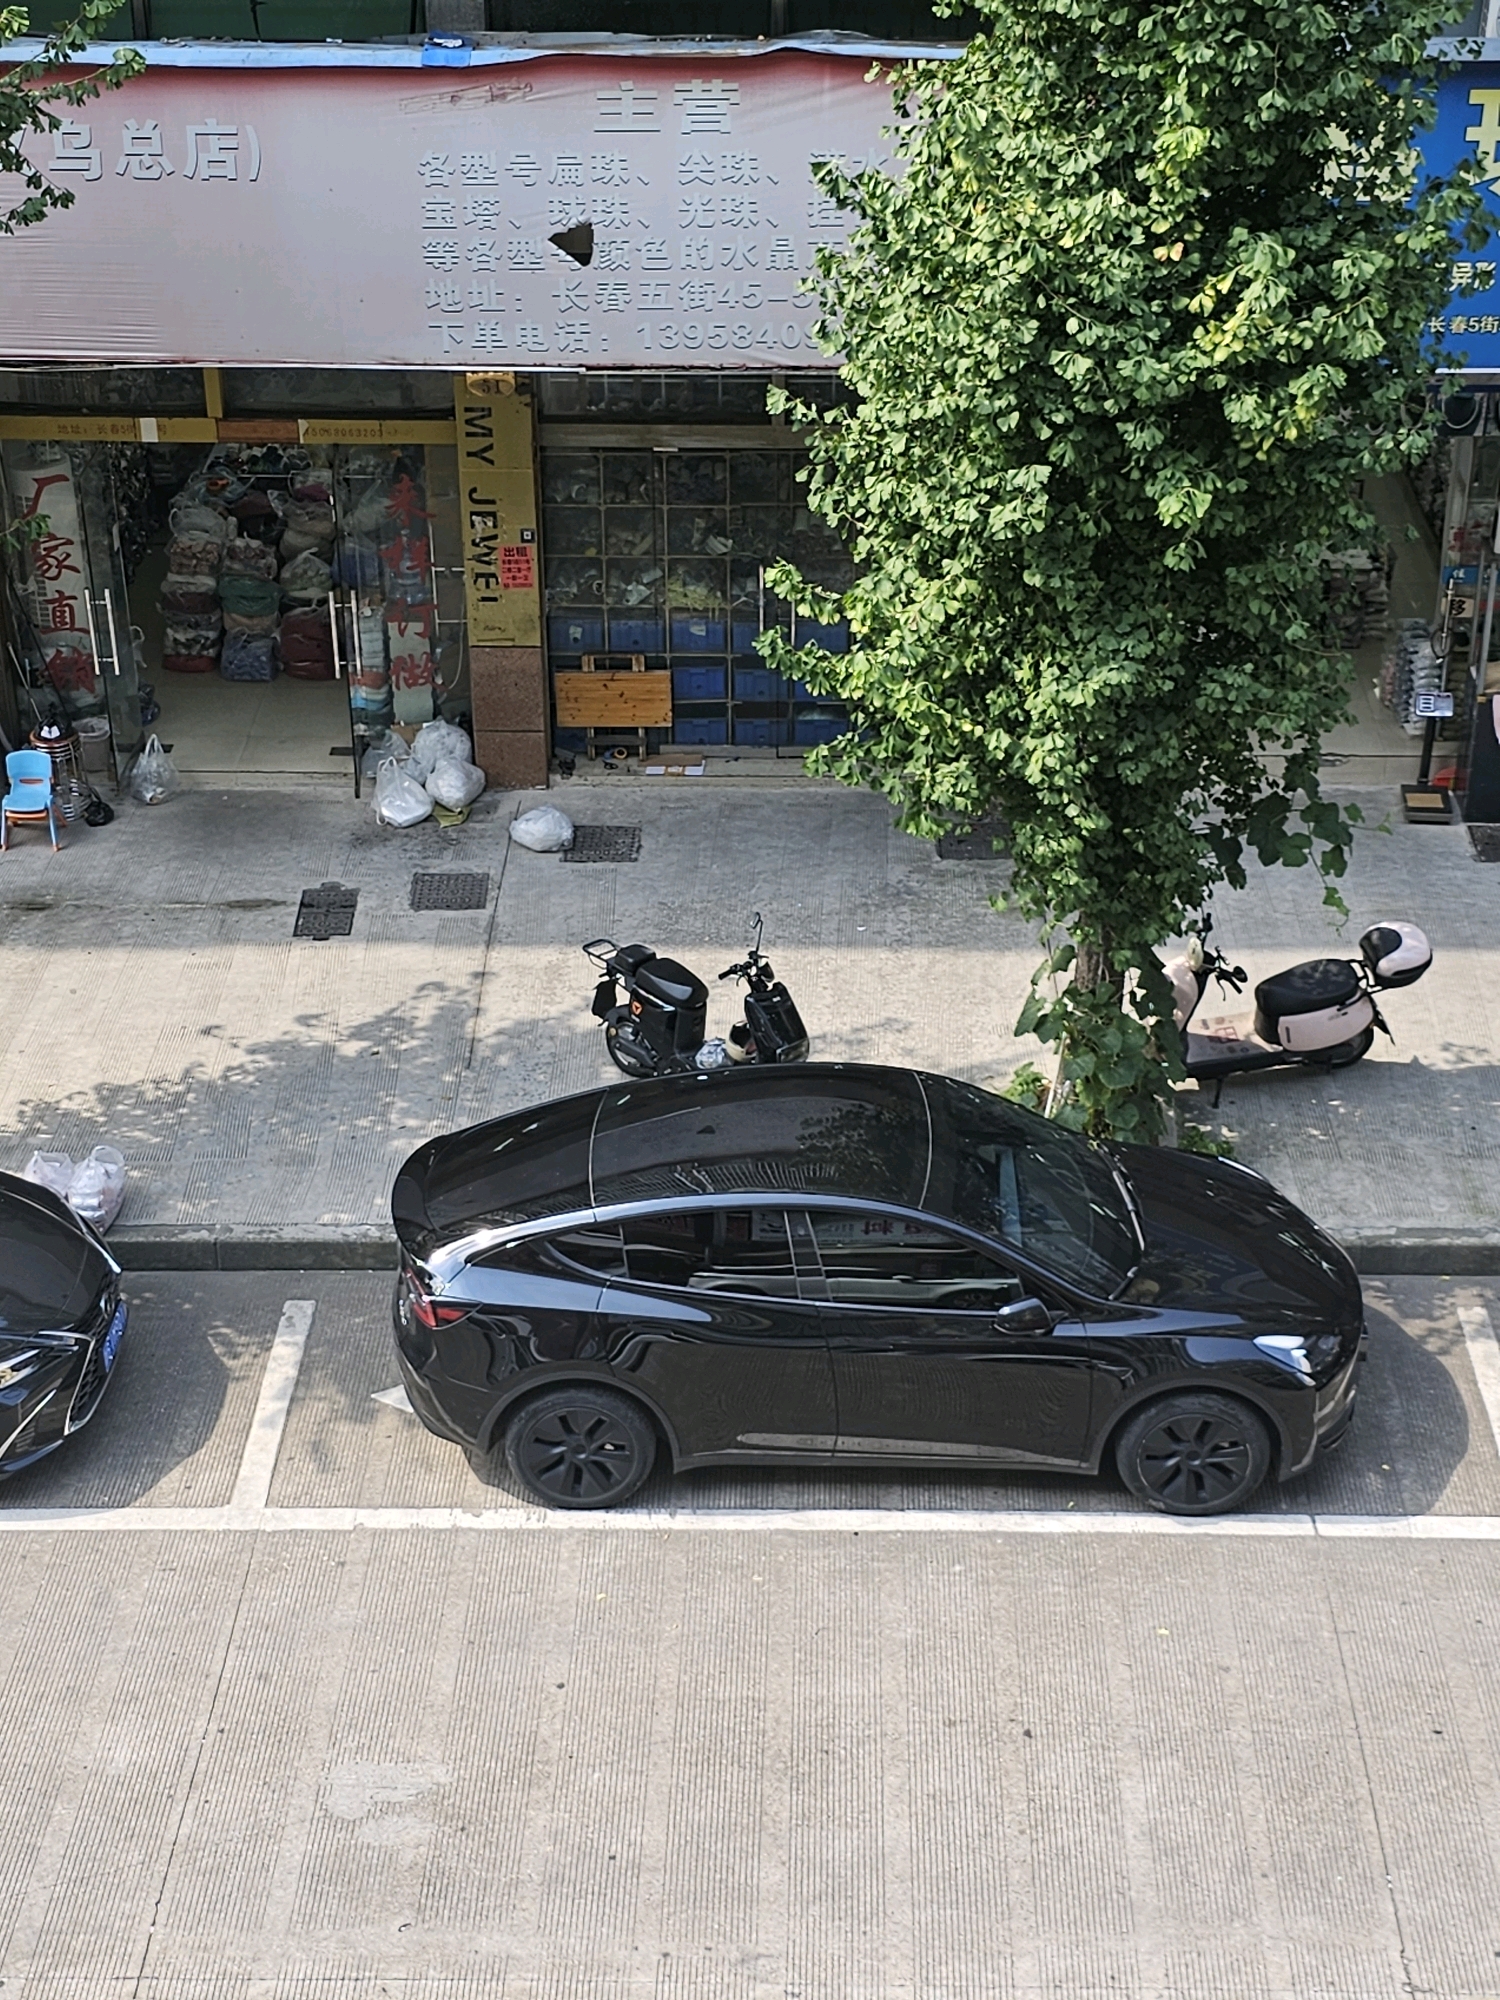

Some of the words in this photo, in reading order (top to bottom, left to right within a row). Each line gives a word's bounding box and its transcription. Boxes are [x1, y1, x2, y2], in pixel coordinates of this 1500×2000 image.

[594, 78, 740, 135] 主营
[9, 117, 263, 183] 乌总店)
[464, 406, 494, 466] MY
